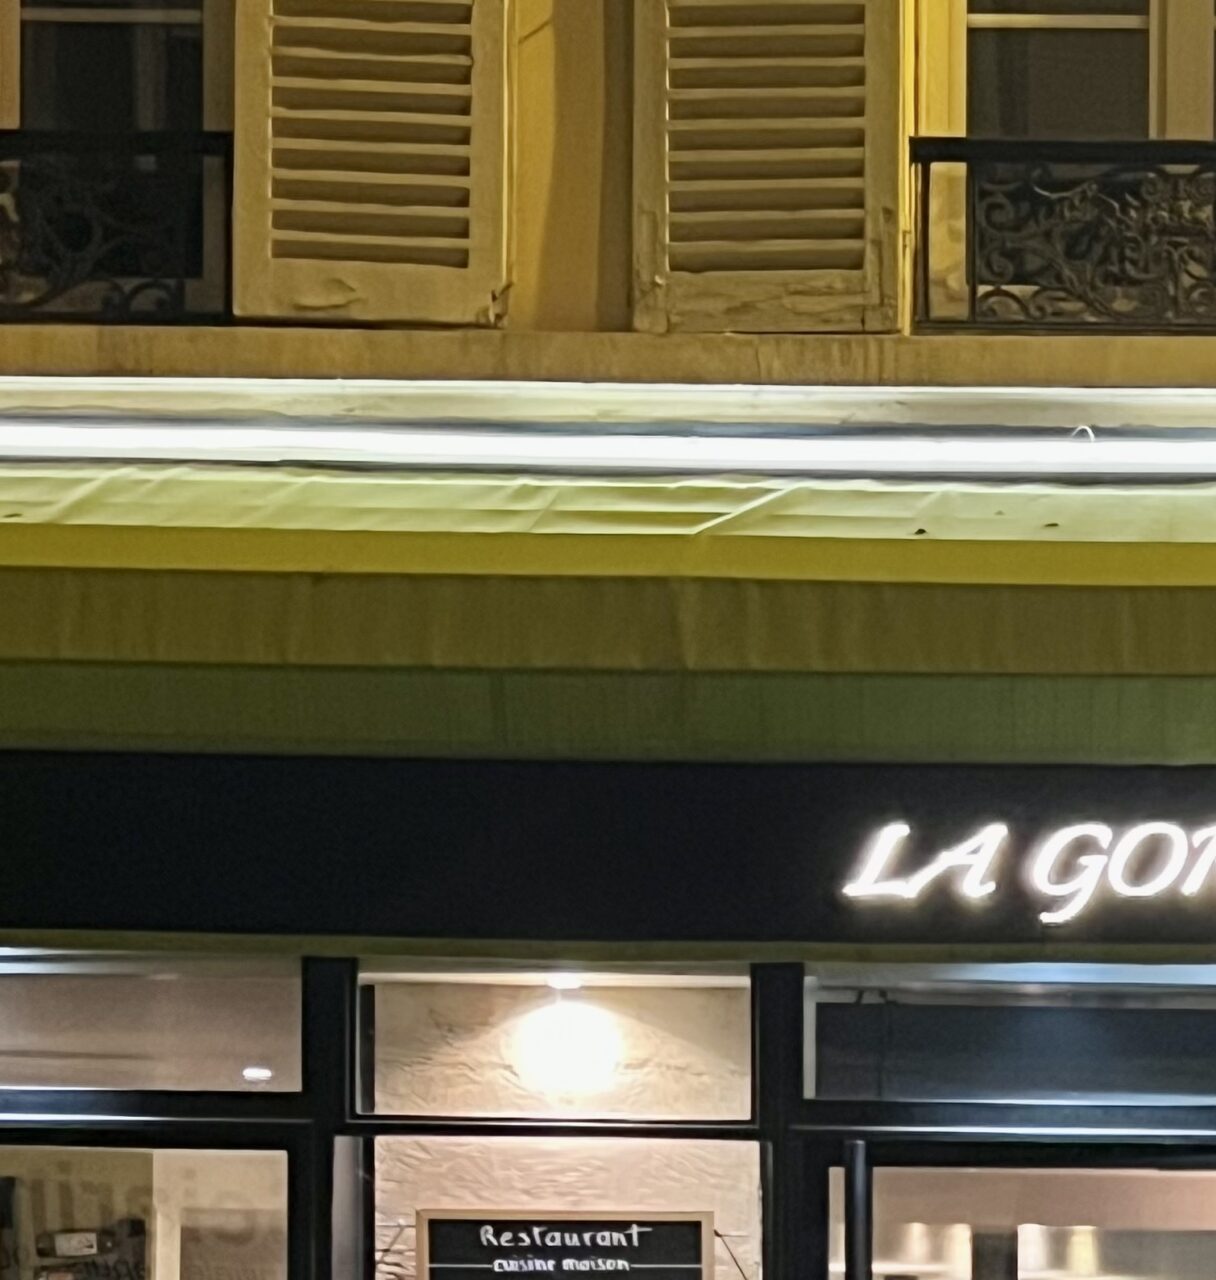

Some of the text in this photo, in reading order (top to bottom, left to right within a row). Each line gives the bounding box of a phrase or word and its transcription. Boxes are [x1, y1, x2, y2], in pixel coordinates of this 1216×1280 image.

[842, 820, 1008, 899] LA
[480, 1224, 653, 1247] Restaurant
[493, 1256, 630, 1272] cuisine maison
